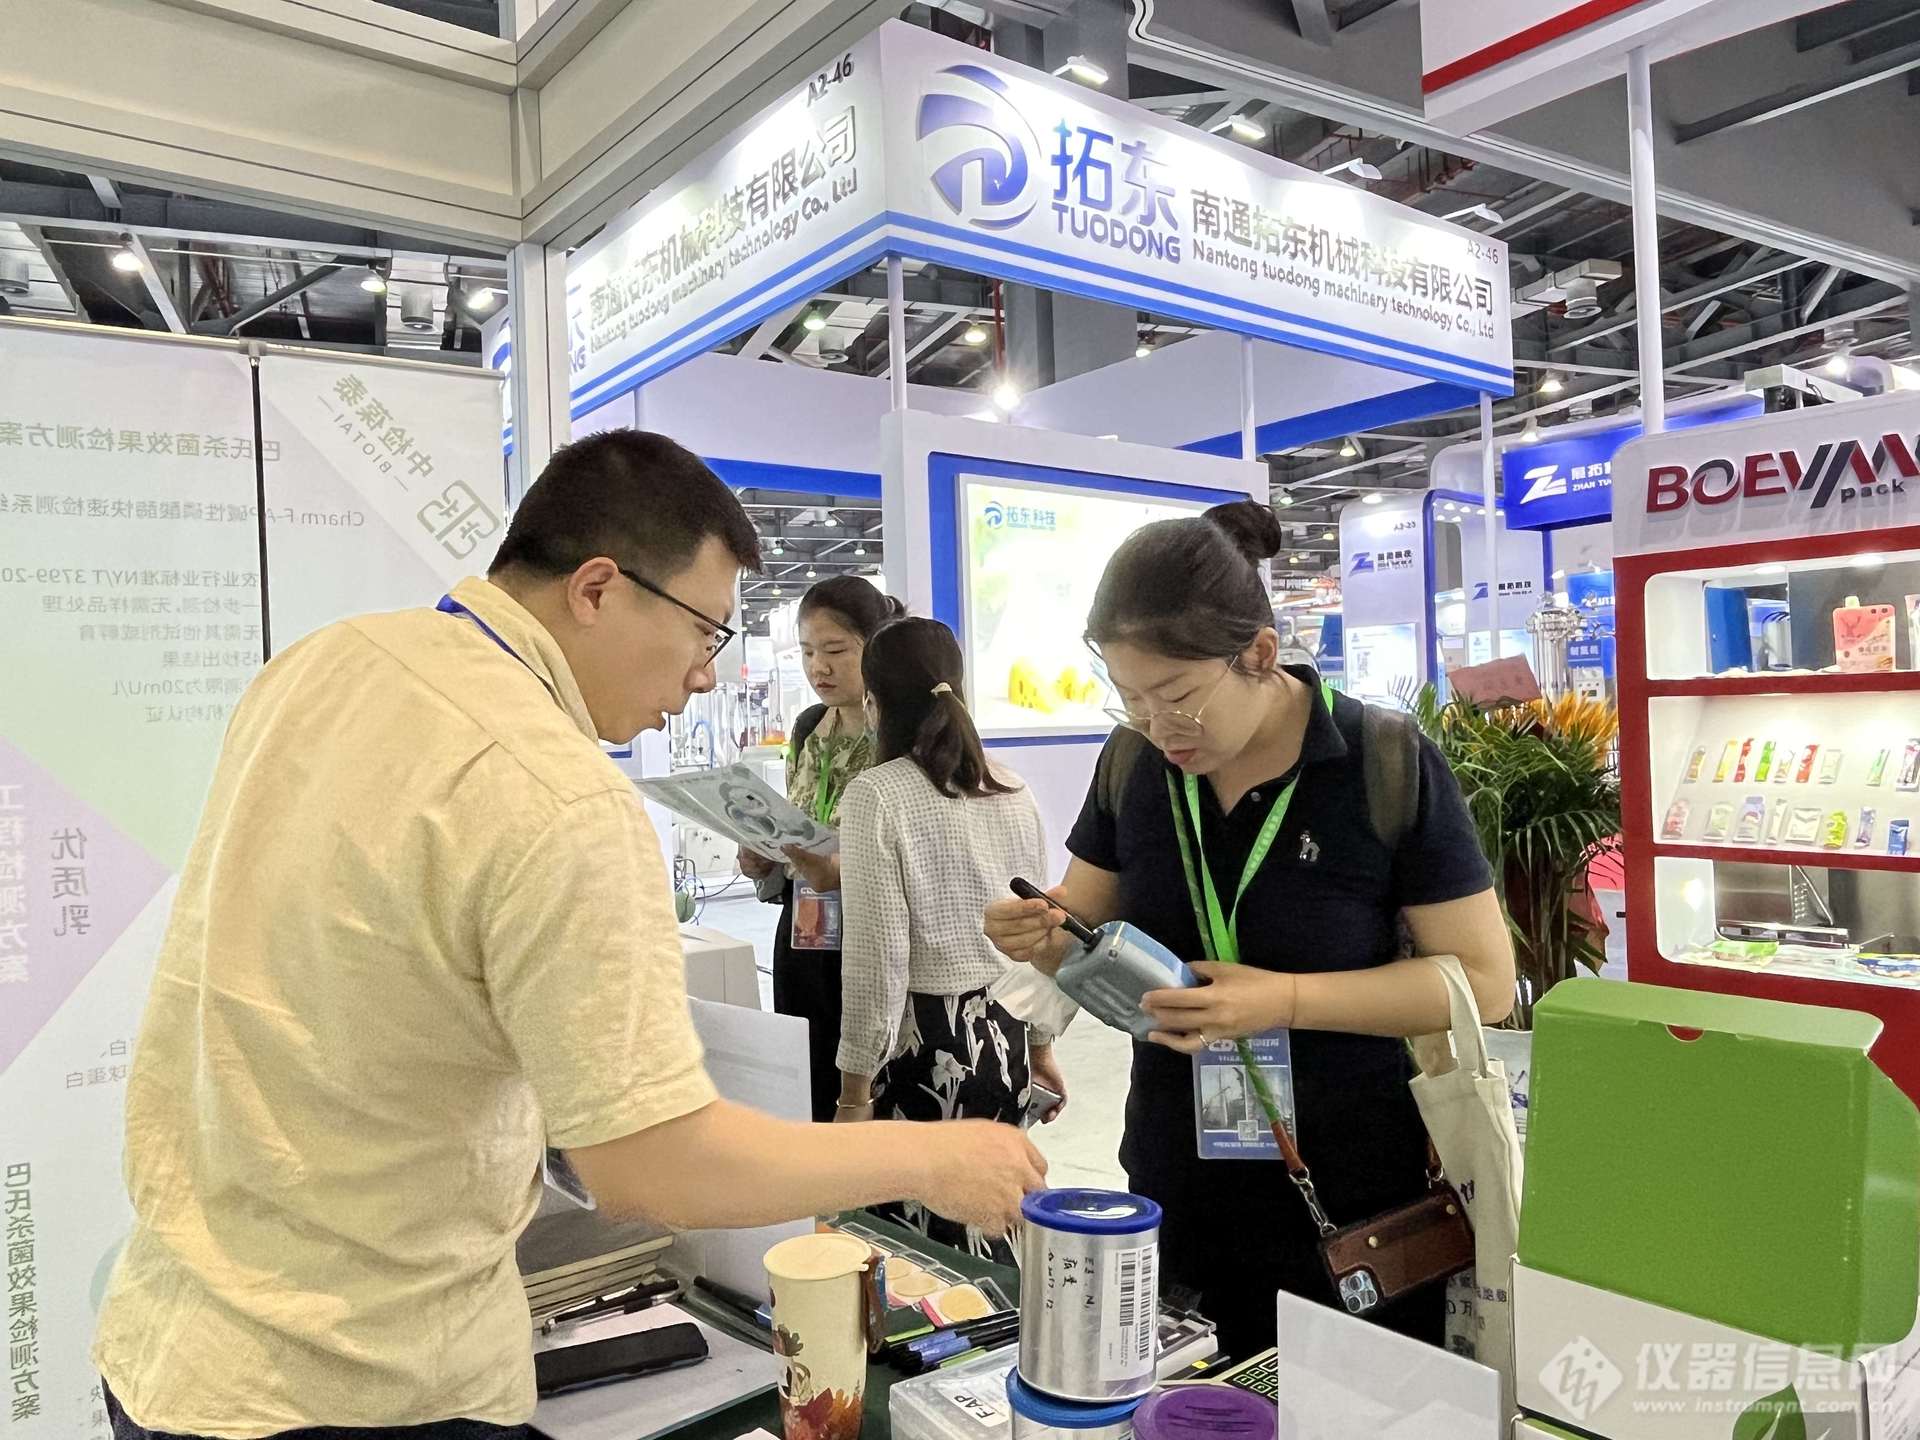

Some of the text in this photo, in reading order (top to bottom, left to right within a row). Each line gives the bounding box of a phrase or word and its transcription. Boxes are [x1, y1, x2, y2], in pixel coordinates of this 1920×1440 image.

[807, 52, 854, 107] A2-46
[1051, 118, 1178, 231] 拓东
[1051, 202, 1181, 264] TUODONG
[1190, 188, 1493, 316] 南通拓东机械科技有限公司
[1467, 239, 1499, 264] A2-46
[1192, 238, 1258, 280] Nantong
[1263, 260, 1320, 297] tuodong
[1324, 279, 1388, 314] machinery
[1391, 297, 1453, 331] technology
[1479, 320, 1494, 339] Ltd
[1840, 479, 1905, 504] pack
[954, 1395, 995, 1418] F-AP
